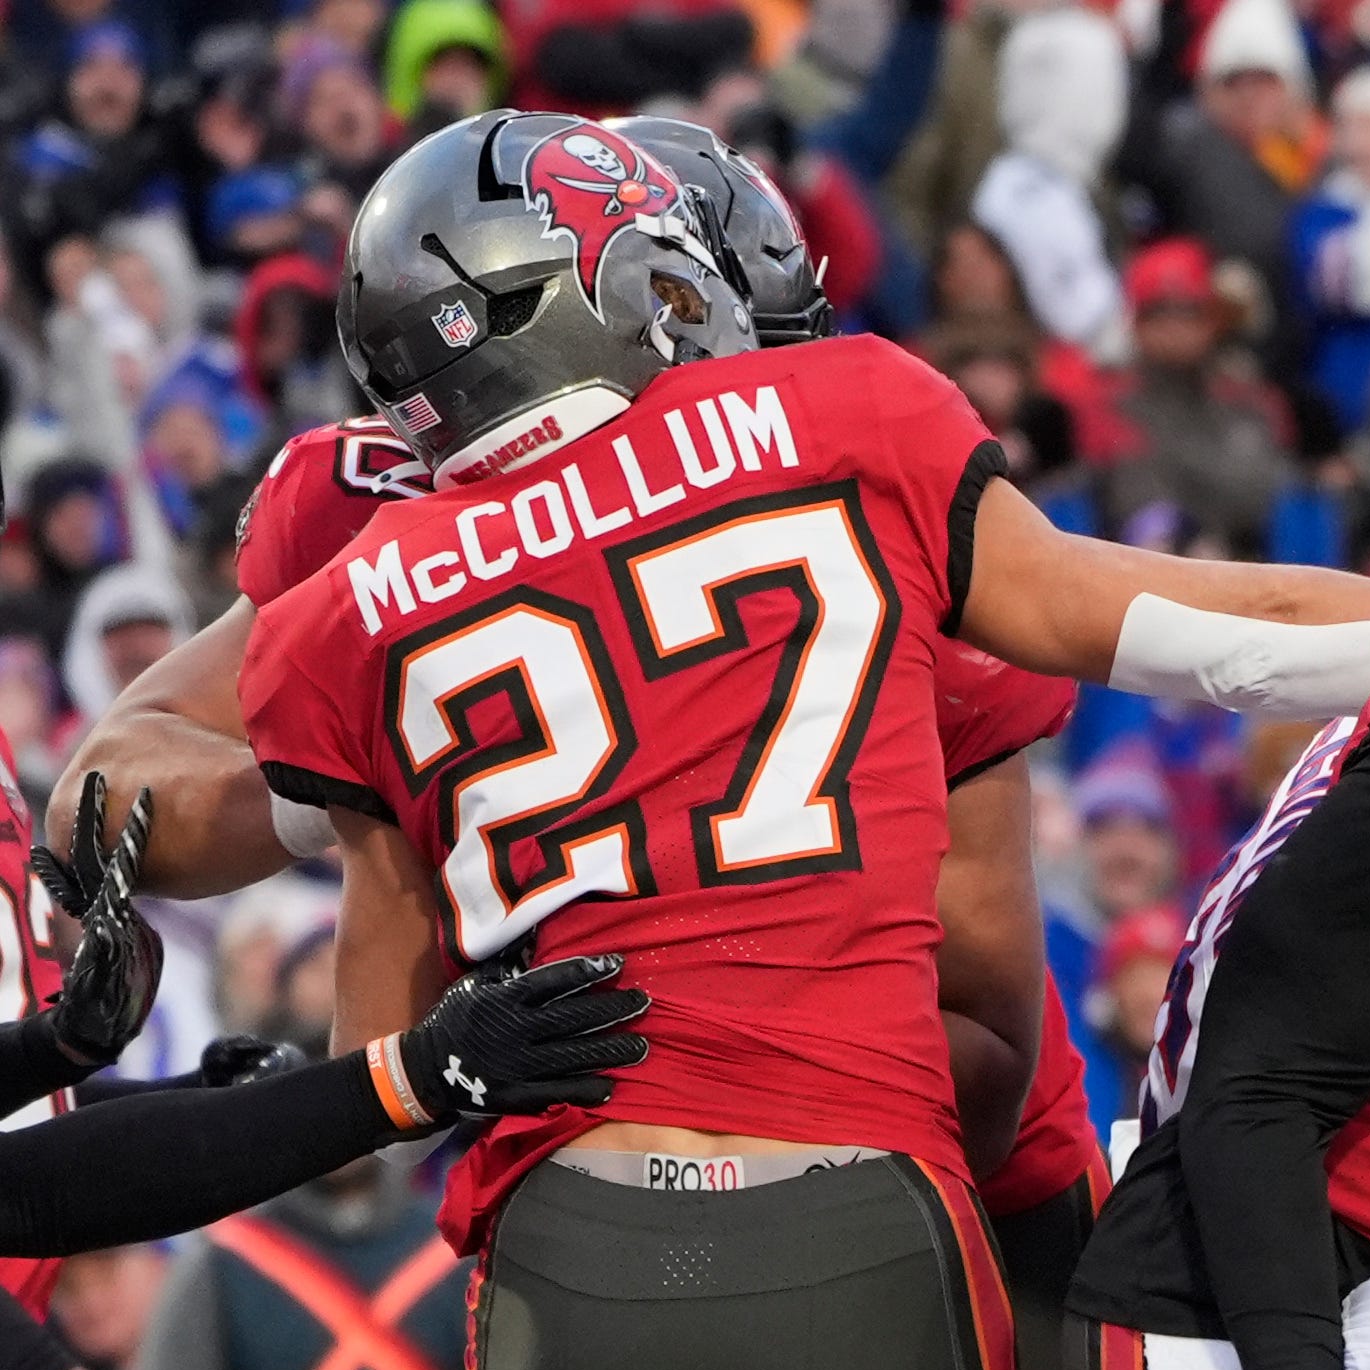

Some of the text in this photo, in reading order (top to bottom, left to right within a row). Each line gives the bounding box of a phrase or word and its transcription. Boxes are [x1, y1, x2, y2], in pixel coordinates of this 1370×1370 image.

[444, 320, 473, 342] NFL
[346, 386, 799, 637] McCOLLUM
[384, 478, 902, 966] 27
